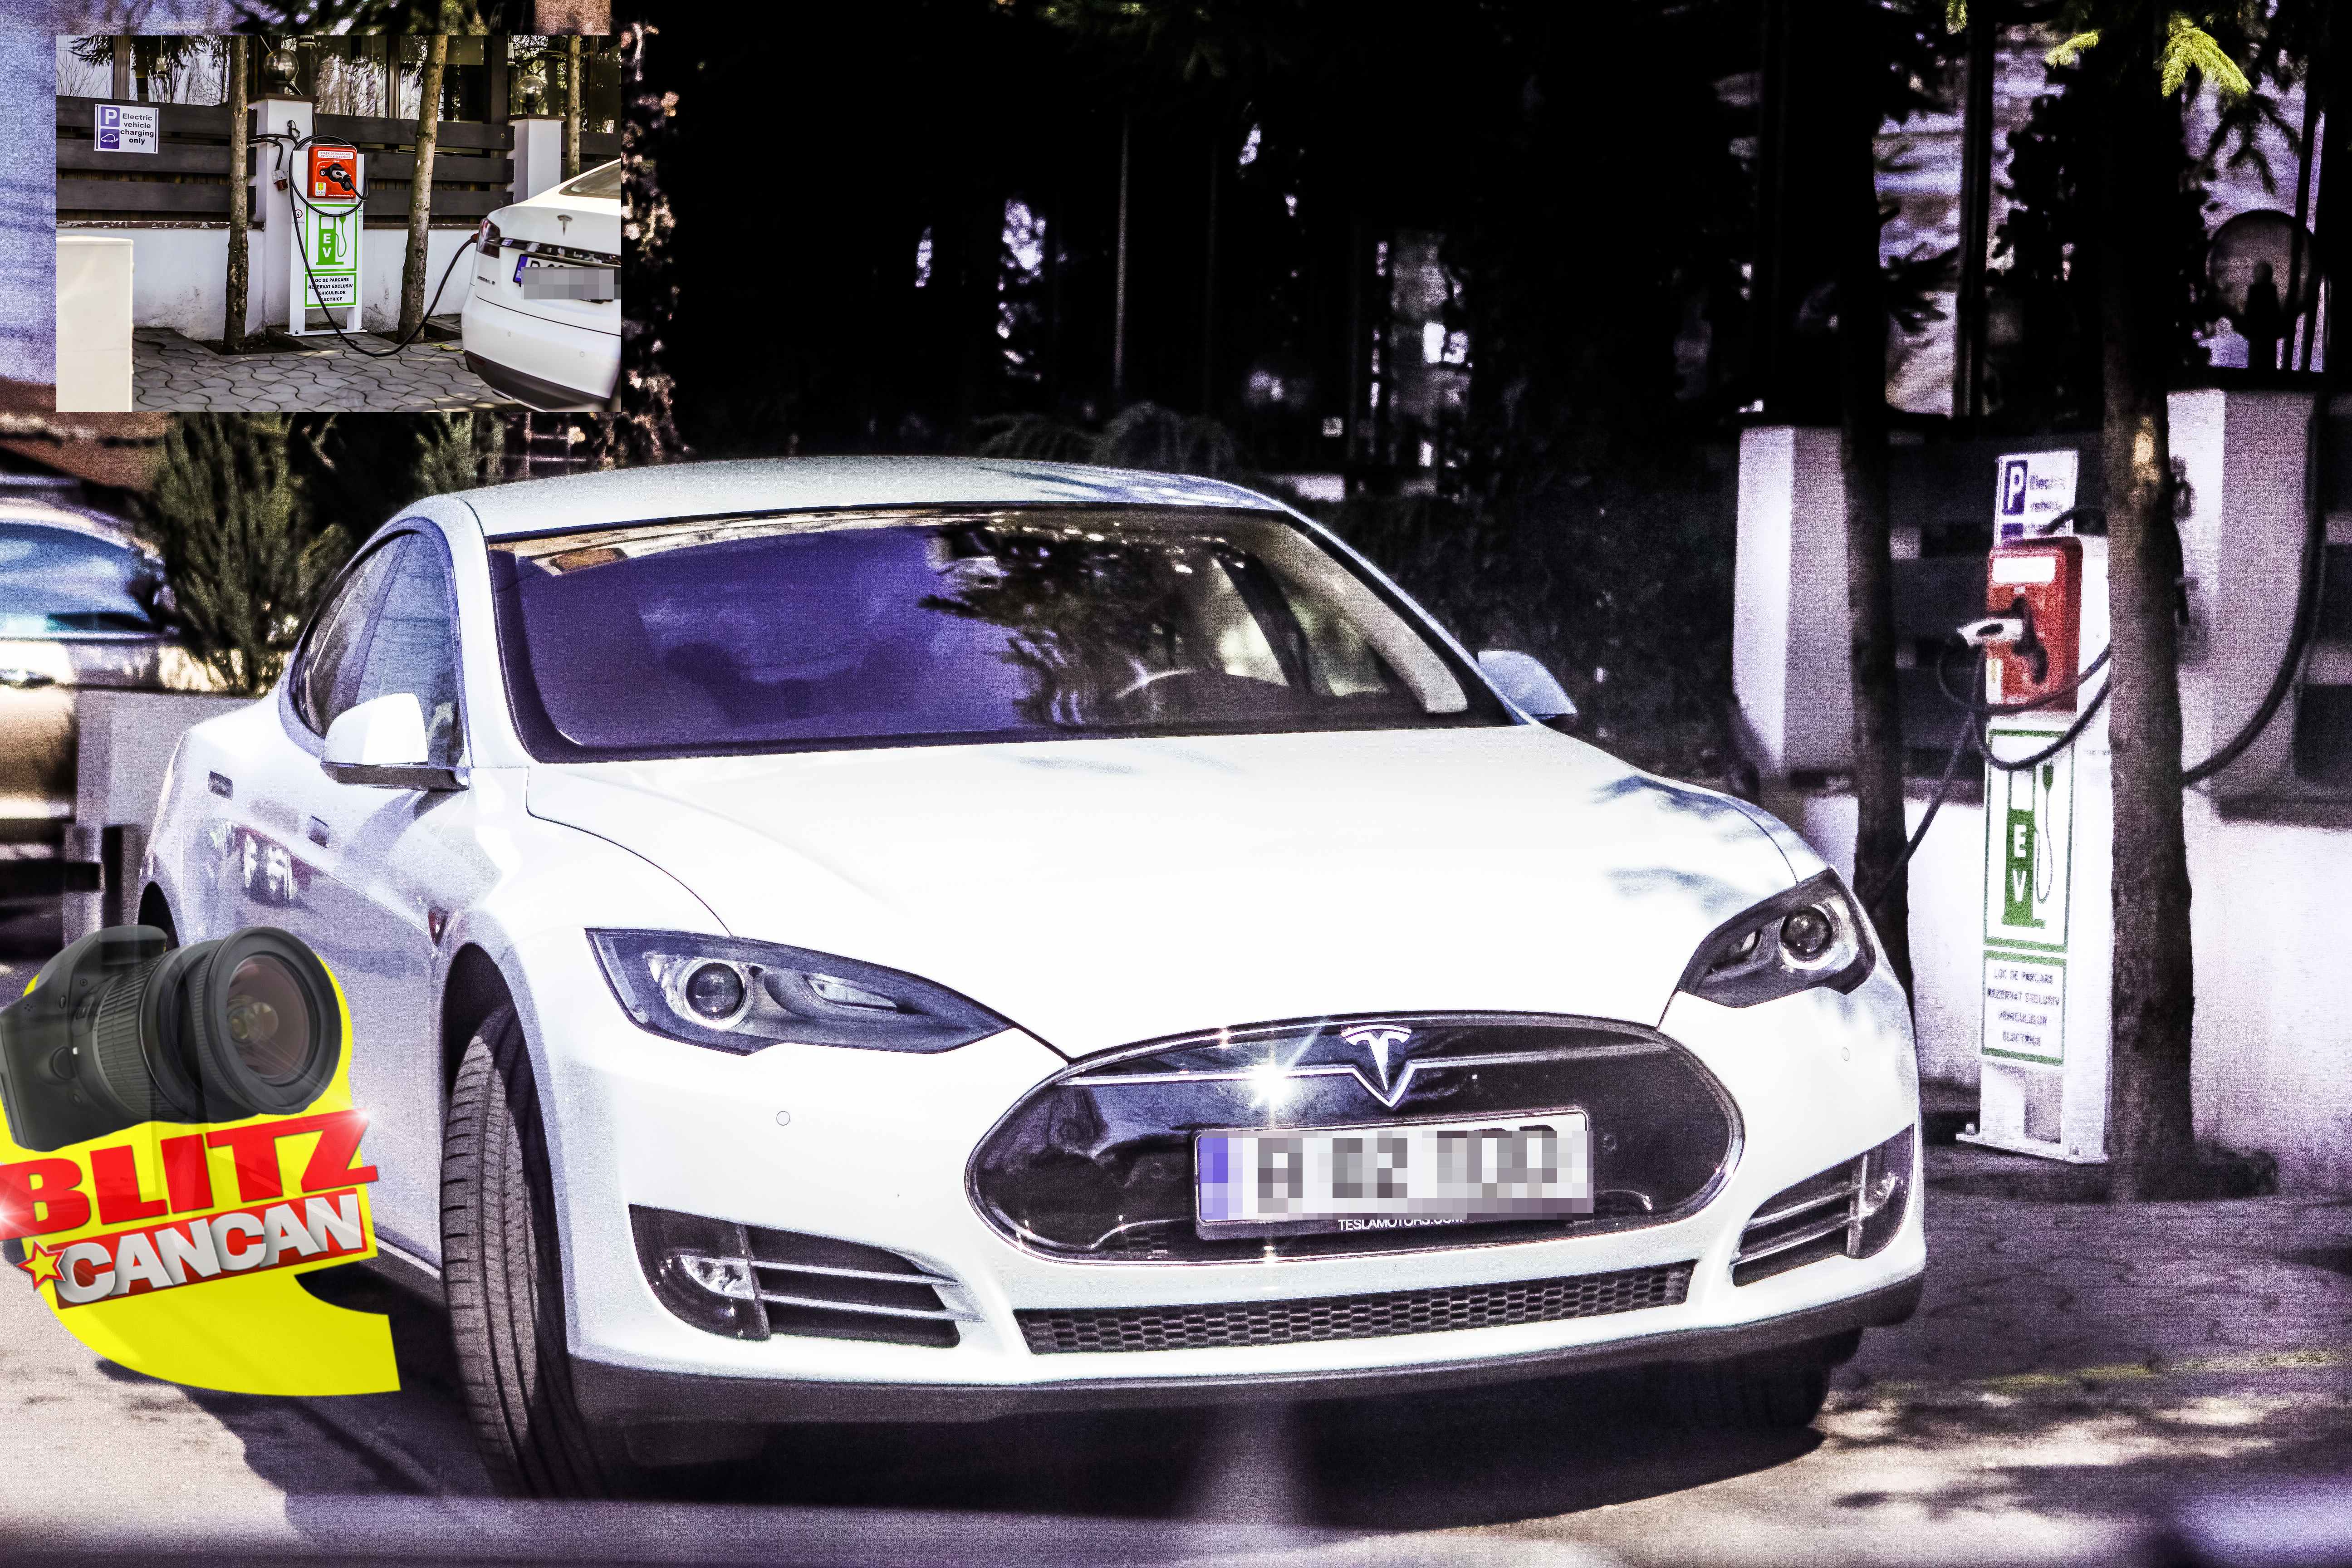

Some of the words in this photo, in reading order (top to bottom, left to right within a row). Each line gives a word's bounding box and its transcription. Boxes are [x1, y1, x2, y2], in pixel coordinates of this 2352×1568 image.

[105, 109, 117, 125] P
[120, 129, 154, 137] charging
[2008, 466, 2024, 508] P
[2010, 970, 2019, 980] DE
